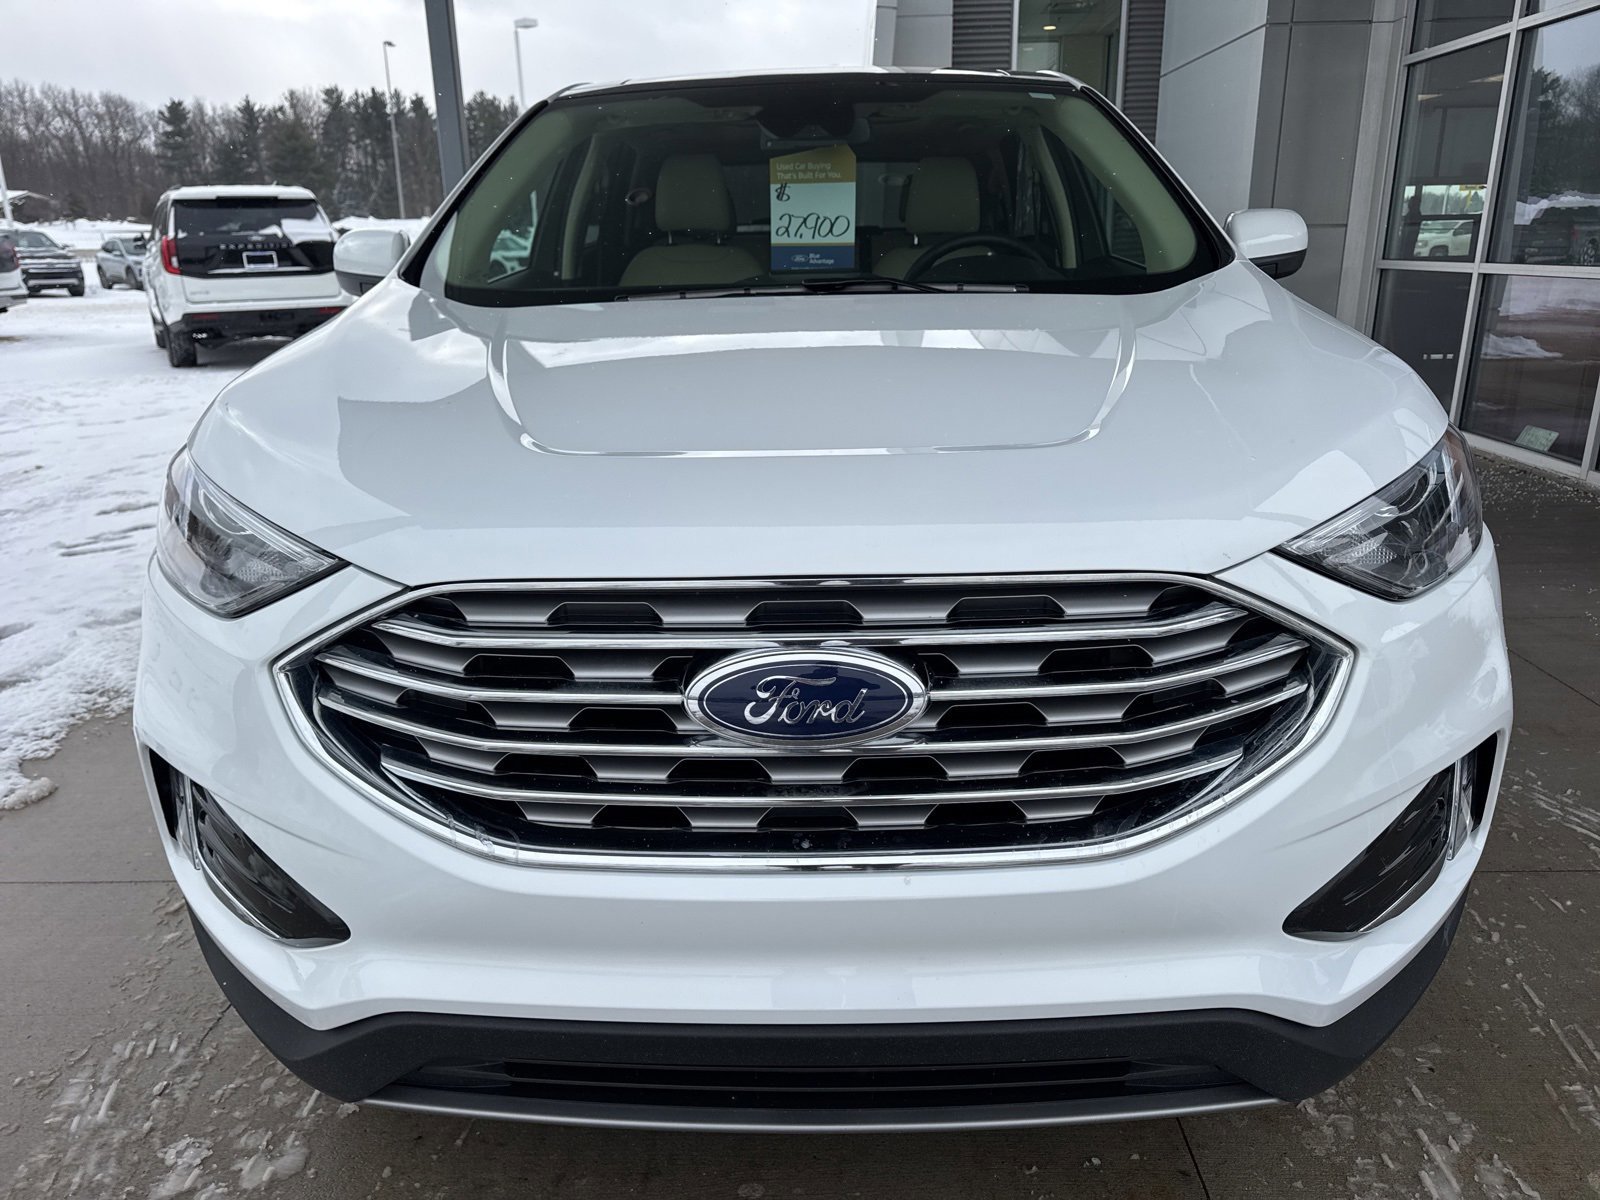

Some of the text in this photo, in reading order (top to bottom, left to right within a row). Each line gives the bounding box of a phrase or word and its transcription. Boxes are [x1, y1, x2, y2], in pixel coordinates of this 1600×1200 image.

[776, 162, 831, 170] Used Car Buying
[798, 171, 814, 180] Built
[815, 171, 826, 179] For
[775, 182, 791, 202] $
[743, 674, 869, 726] Ford
